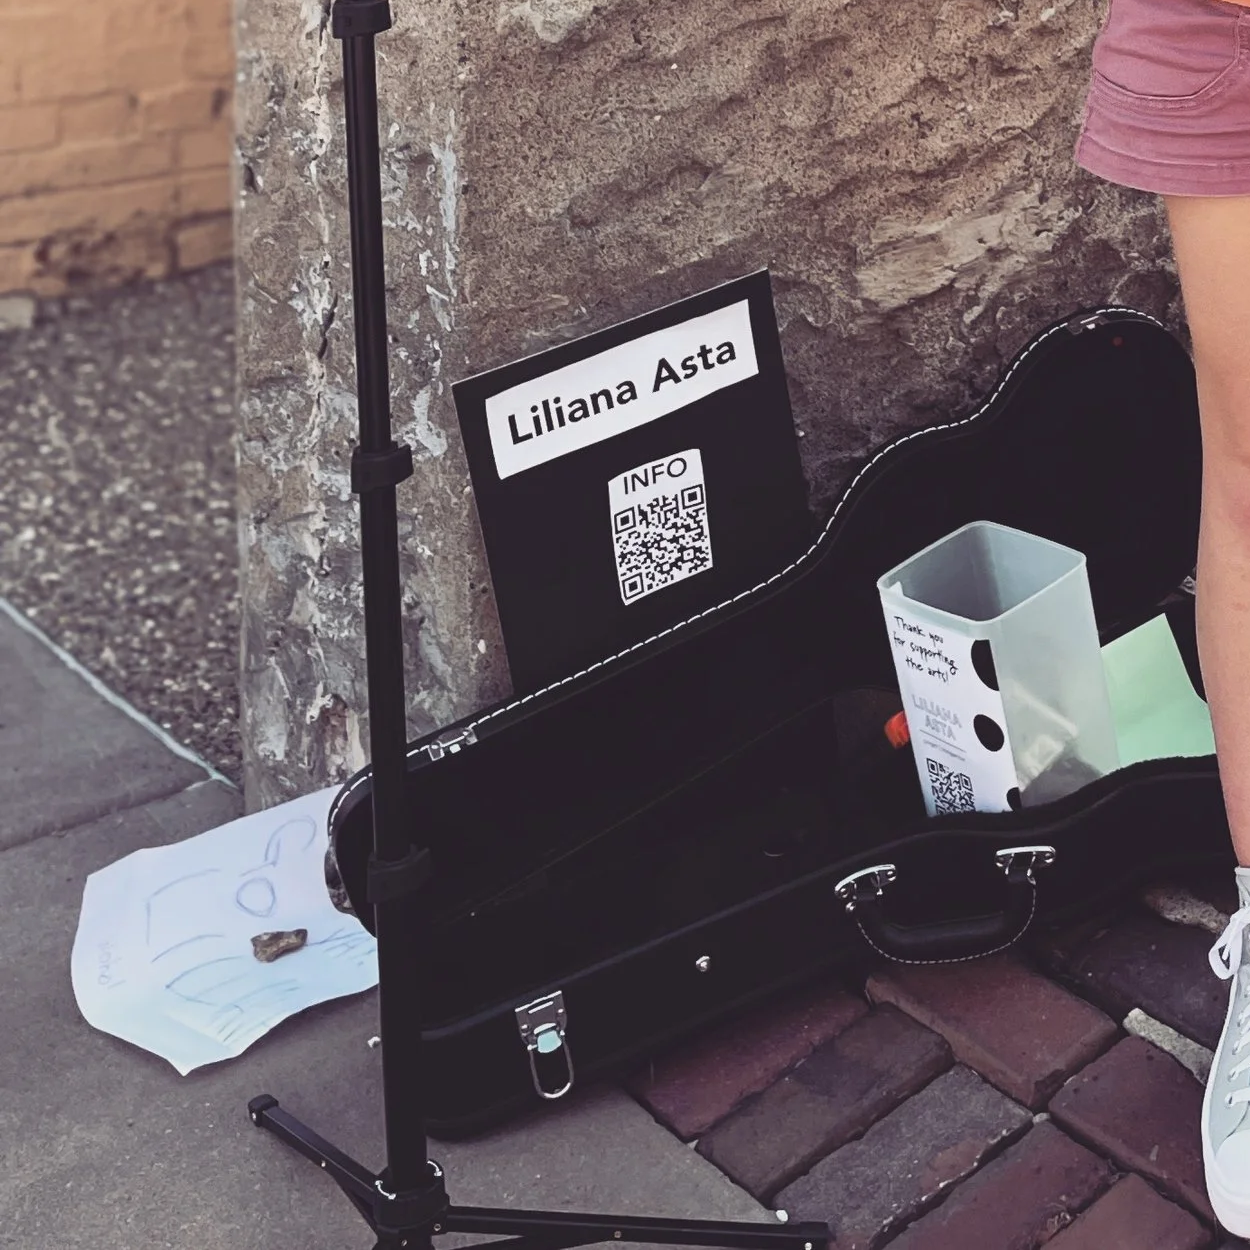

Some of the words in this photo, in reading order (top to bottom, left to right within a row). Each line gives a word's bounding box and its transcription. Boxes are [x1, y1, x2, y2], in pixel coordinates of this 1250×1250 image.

[507, 379, 638, 445] Liliana
[652, 340, 737, 392] Asta
[622, 456, 688, 495] INFO
[893, 615, 926, 638] Thank
[928, 631, 944, 648] you
[893, 630, 905, 647] for
[909, 641, 959, 676] supporting
[905, 655, 923, 671] the
[927, 667, 949, 684] arts!
